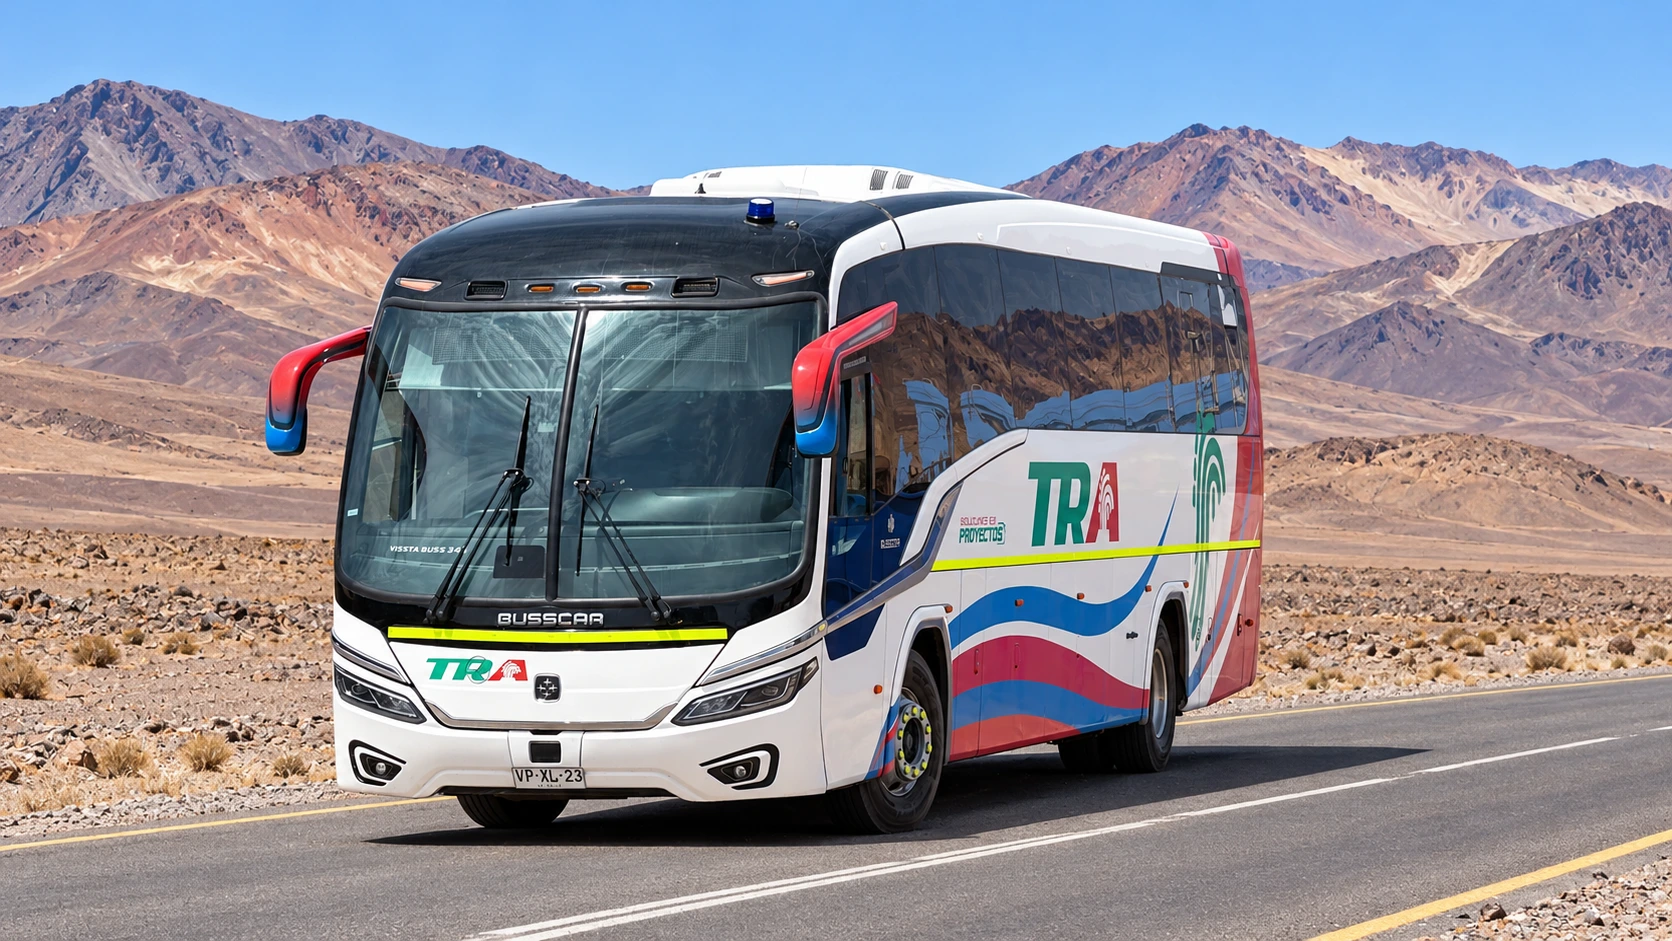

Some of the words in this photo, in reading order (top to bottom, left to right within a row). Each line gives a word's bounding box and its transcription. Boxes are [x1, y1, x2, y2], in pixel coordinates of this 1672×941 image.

[1028, 462, 1120, 547] TRA
[390, 545, 419, 553] VISSTA
[421, 546, 446, 554] BUSS
[498, 613, 604, 626] BUSSCAR
[426, 658, 528, 681] TRA
